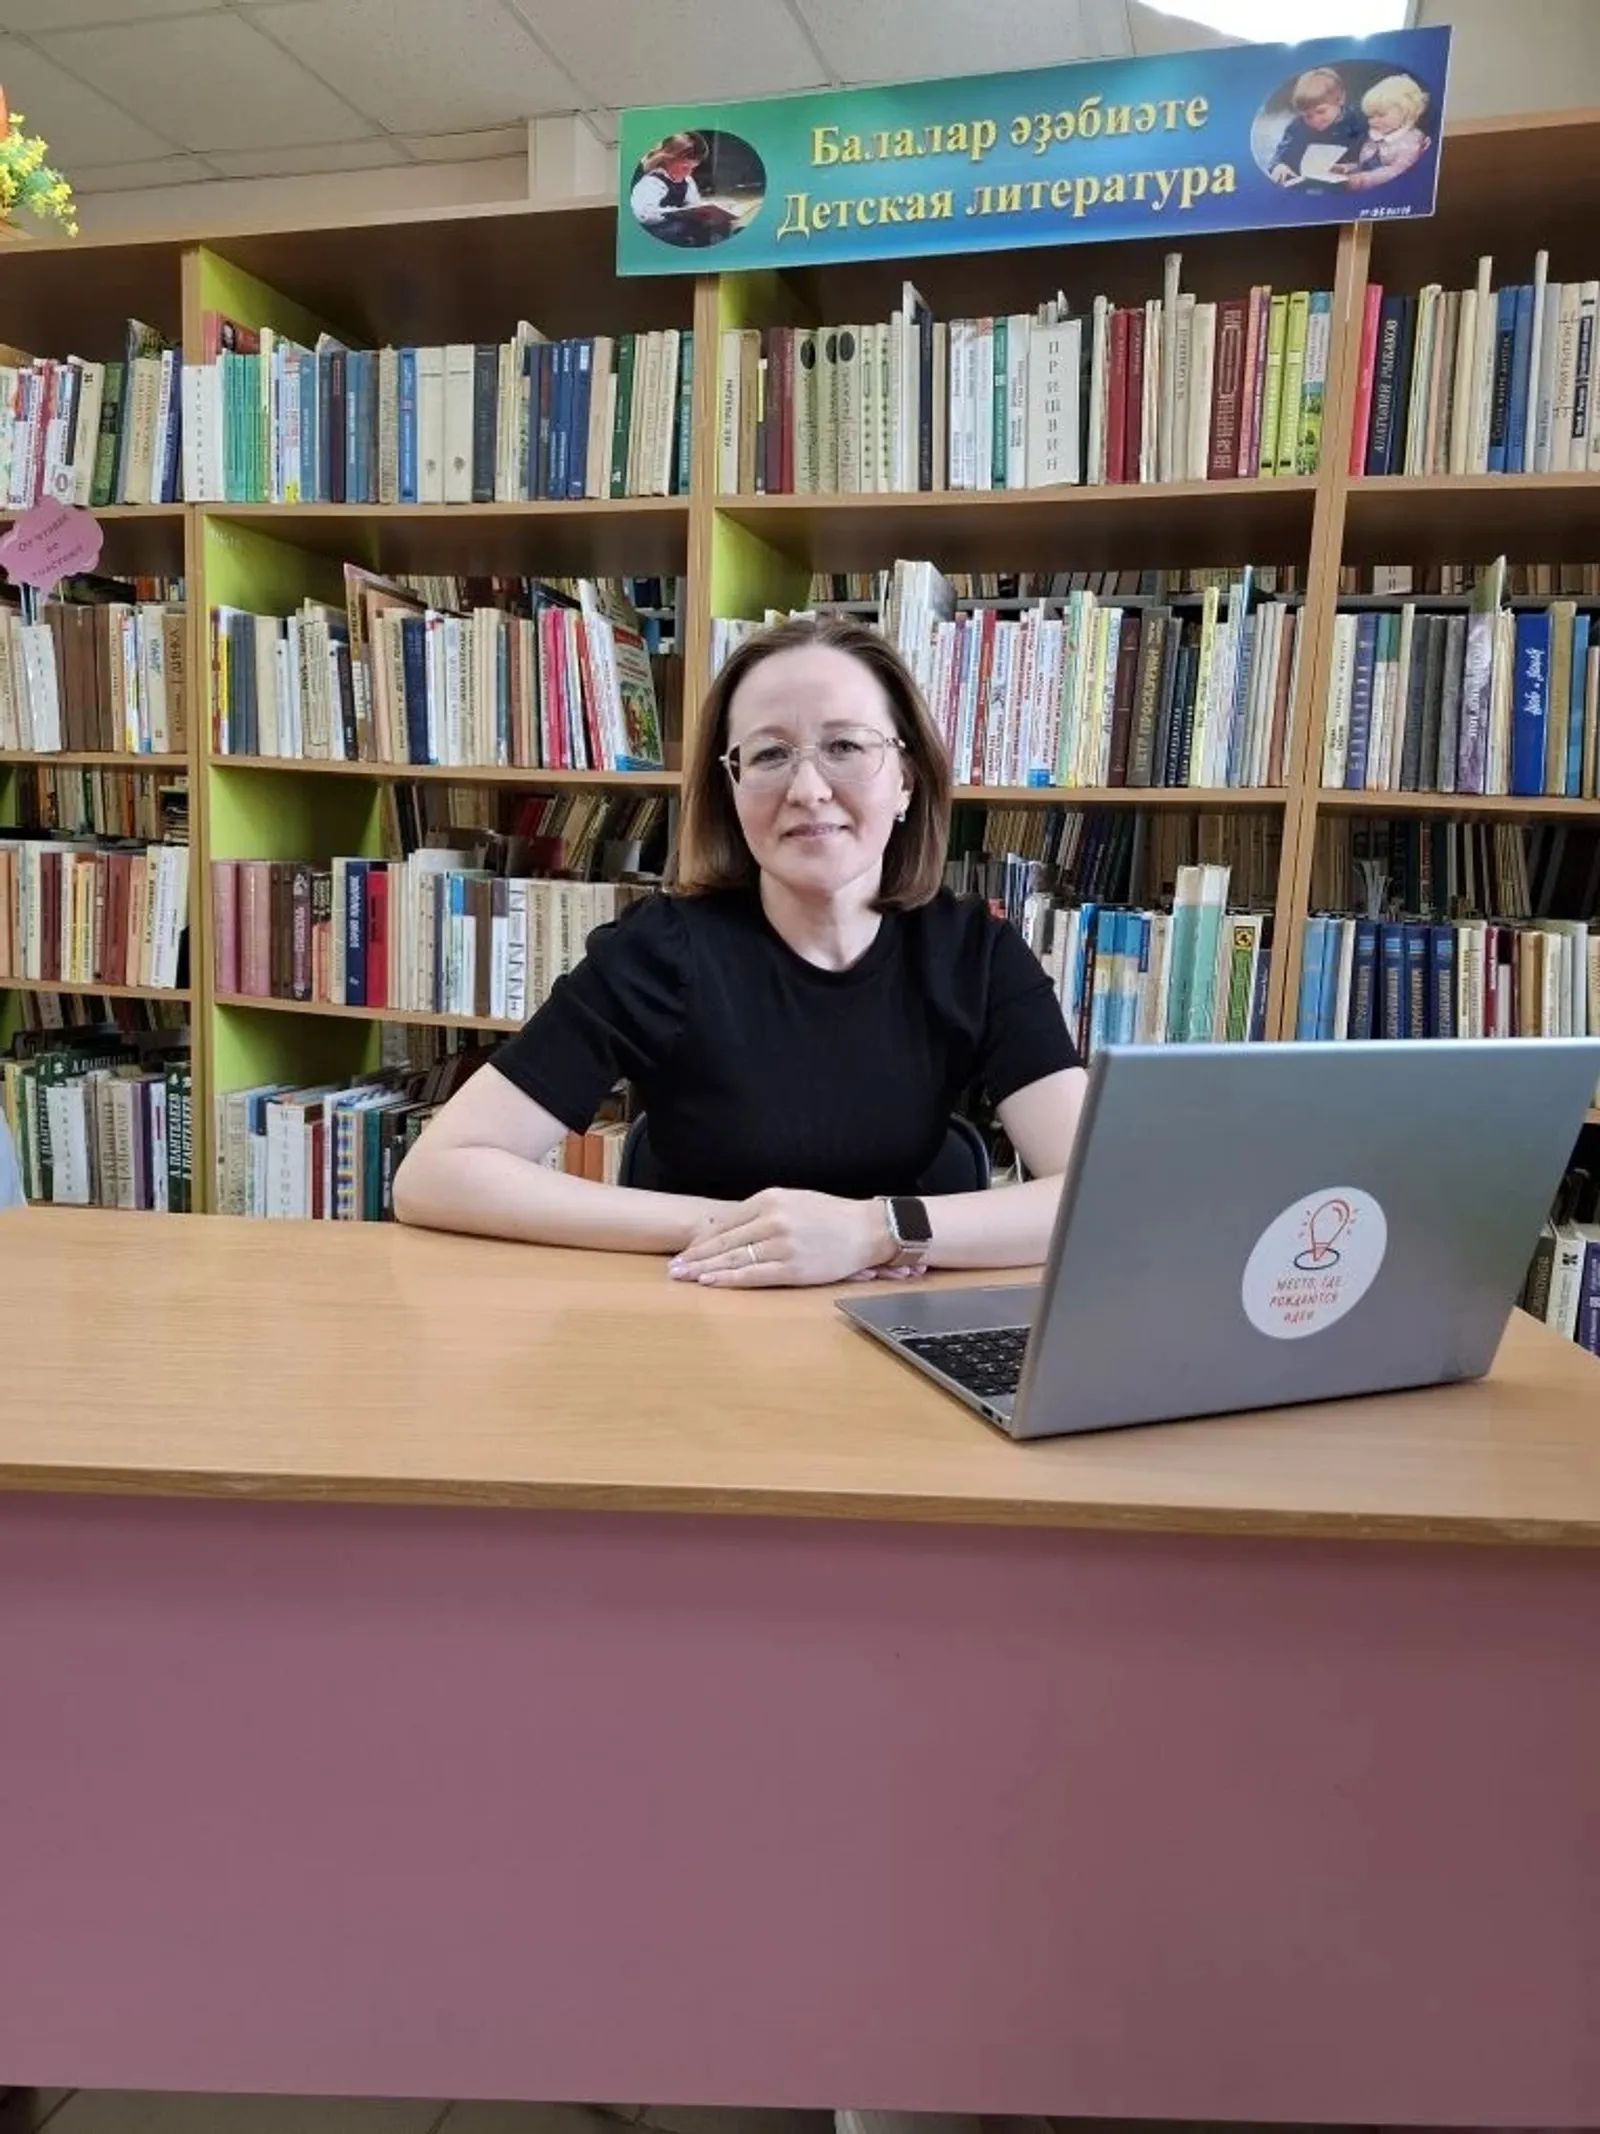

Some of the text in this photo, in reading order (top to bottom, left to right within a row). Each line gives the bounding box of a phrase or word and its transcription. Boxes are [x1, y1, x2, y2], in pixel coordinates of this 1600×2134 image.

[811, 119, 998, 165] Балалар
[777, 160, 1238, 240] Детская литература
[1381, 318, 1399, 378] РЫБАКОВ
[1045, 341, 1061, 471] ПРИШВИН
[1269, 1293, 1339, 1308] РОЖДАЮТСЯ
[1320, 1275, 1345, 1289] ГДЕ
